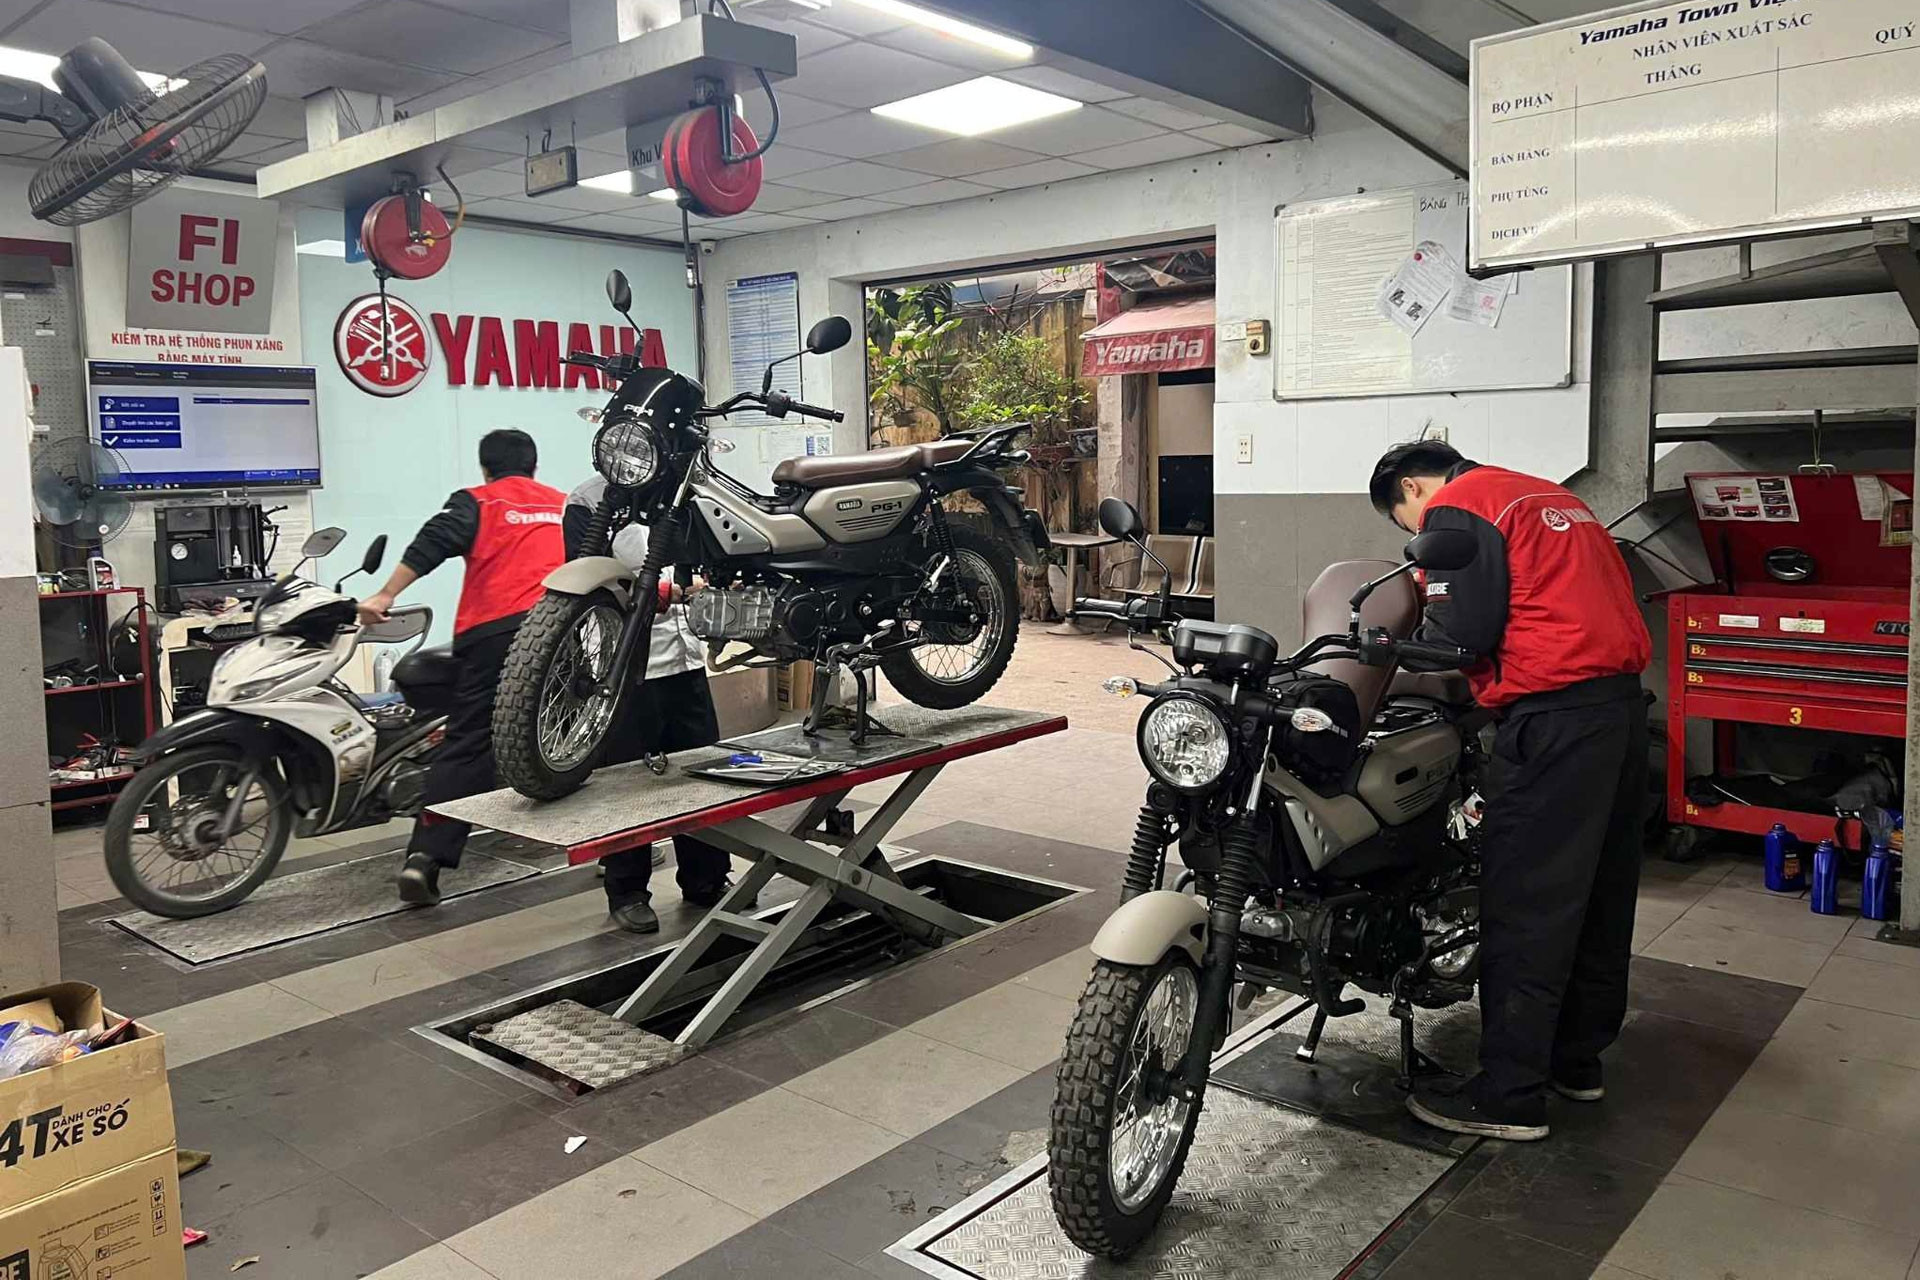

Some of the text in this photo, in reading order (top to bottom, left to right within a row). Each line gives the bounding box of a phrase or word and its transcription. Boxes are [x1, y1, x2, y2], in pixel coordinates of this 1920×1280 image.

[1580, 17, 1668, 45] Yamaha
[1678, 2, 1738, 24] Town
[1876, 21, 1915, 43] QUÝ
[1632, 40, 1677, 59] NHÂN
[1683, 30, 1721, 48] VIÊN
[1644, 63, 1701, 84] THÁNG
[632, 149, 652, 167] Khu
[179, 214, 239, 265] FI
[151, 269, 255, 307] SHOP
[144, 334, 166, 346] TRA
[224, 338, 252, 350] PHUN
[431, 312, 668, 391] YAMAHA
[1094, 335, 1204, 366] Yamaha
[872, 501, 902, 513] PG-1
[1691, 644, 1706, 656] B2
[1688, 672, 1704, 683] B3
[1789, 707, 1802, 725] 3
[51, 1098, 131, 1152] XE SỐ
[52, 1102, 112, 1130] DÀNH CHO
[0, 1105, 63, 1168] 4T
